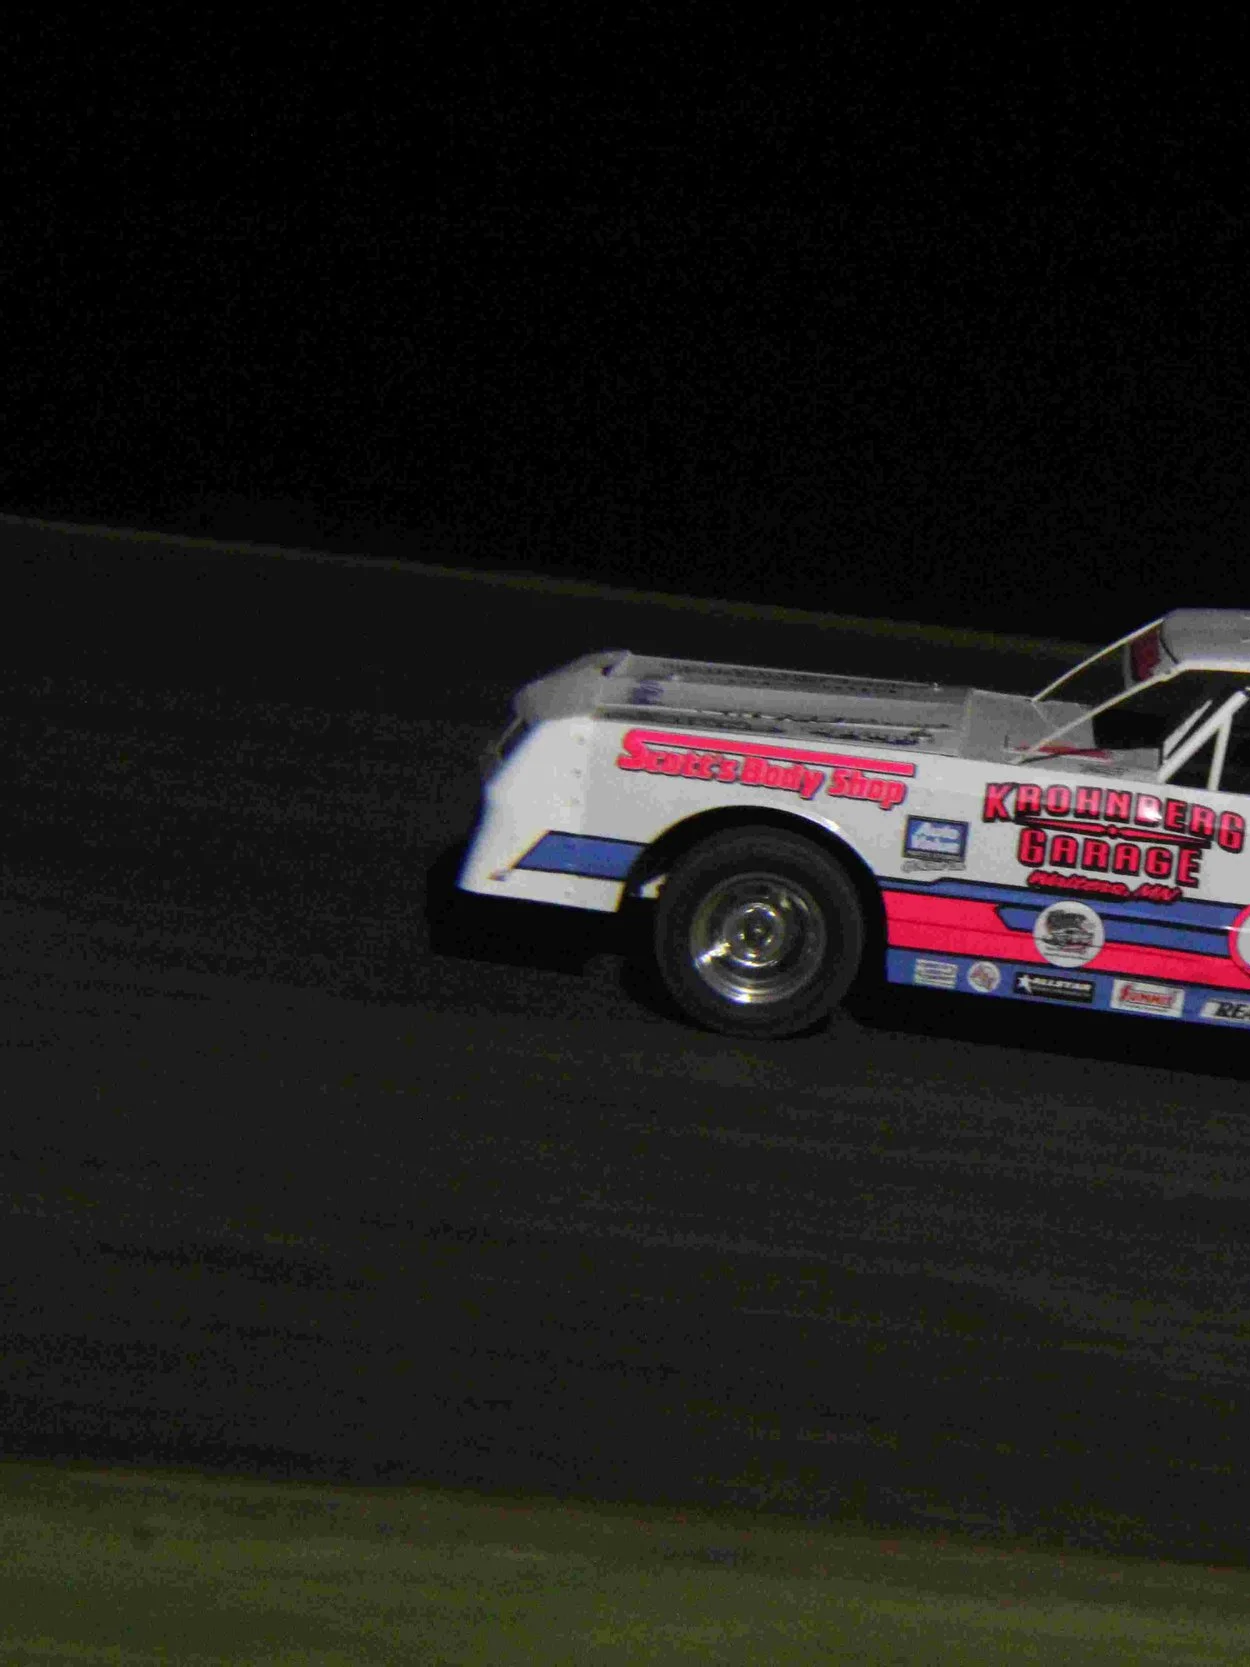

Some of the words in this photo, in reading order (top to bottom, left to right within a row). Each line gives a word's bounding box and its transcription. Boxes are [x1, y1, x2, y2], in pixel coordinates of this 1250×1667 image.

[617, 729, 739, 783] Scott's
[740, 756, 825, 800] Body
[828, 768, 908, 811] Shop
[982, 781, 1246, 854] KROHNBERG
[1018, 826, 1204, 888] GARAGE
